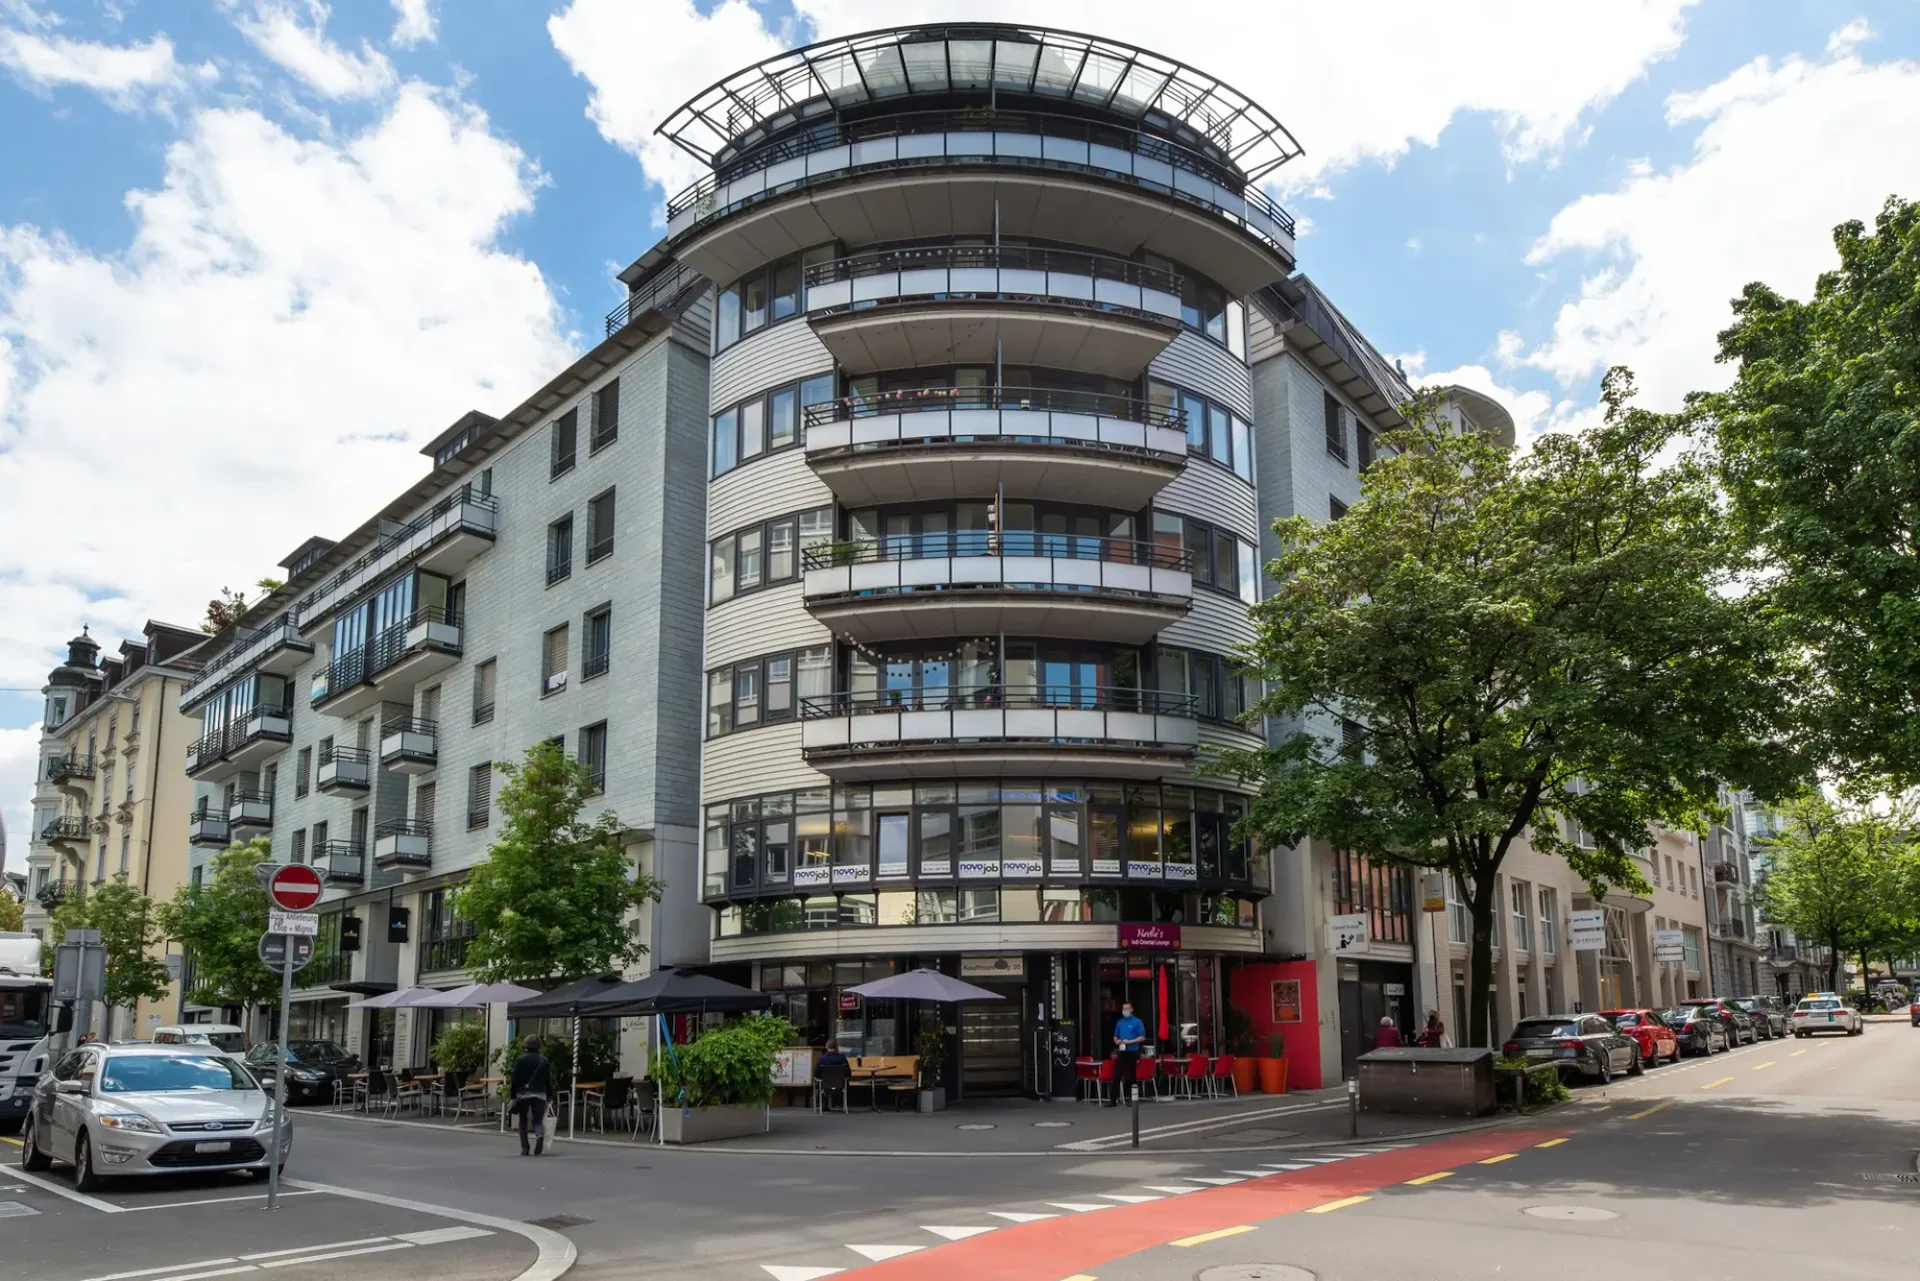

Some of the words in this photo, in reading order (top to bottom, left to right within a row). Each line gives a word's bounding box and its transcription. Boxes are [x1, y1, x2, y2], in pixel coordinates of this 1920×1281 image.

[833, 867, 869, 879] novojob
[960, 862, 998, 874] novojob
[1003, 862, 1041, 874] novojob
[1128, 863, 1161, 875] novojob
[795, 869, 829, 881] novojob
[294, 925, 314, 934] Migros
